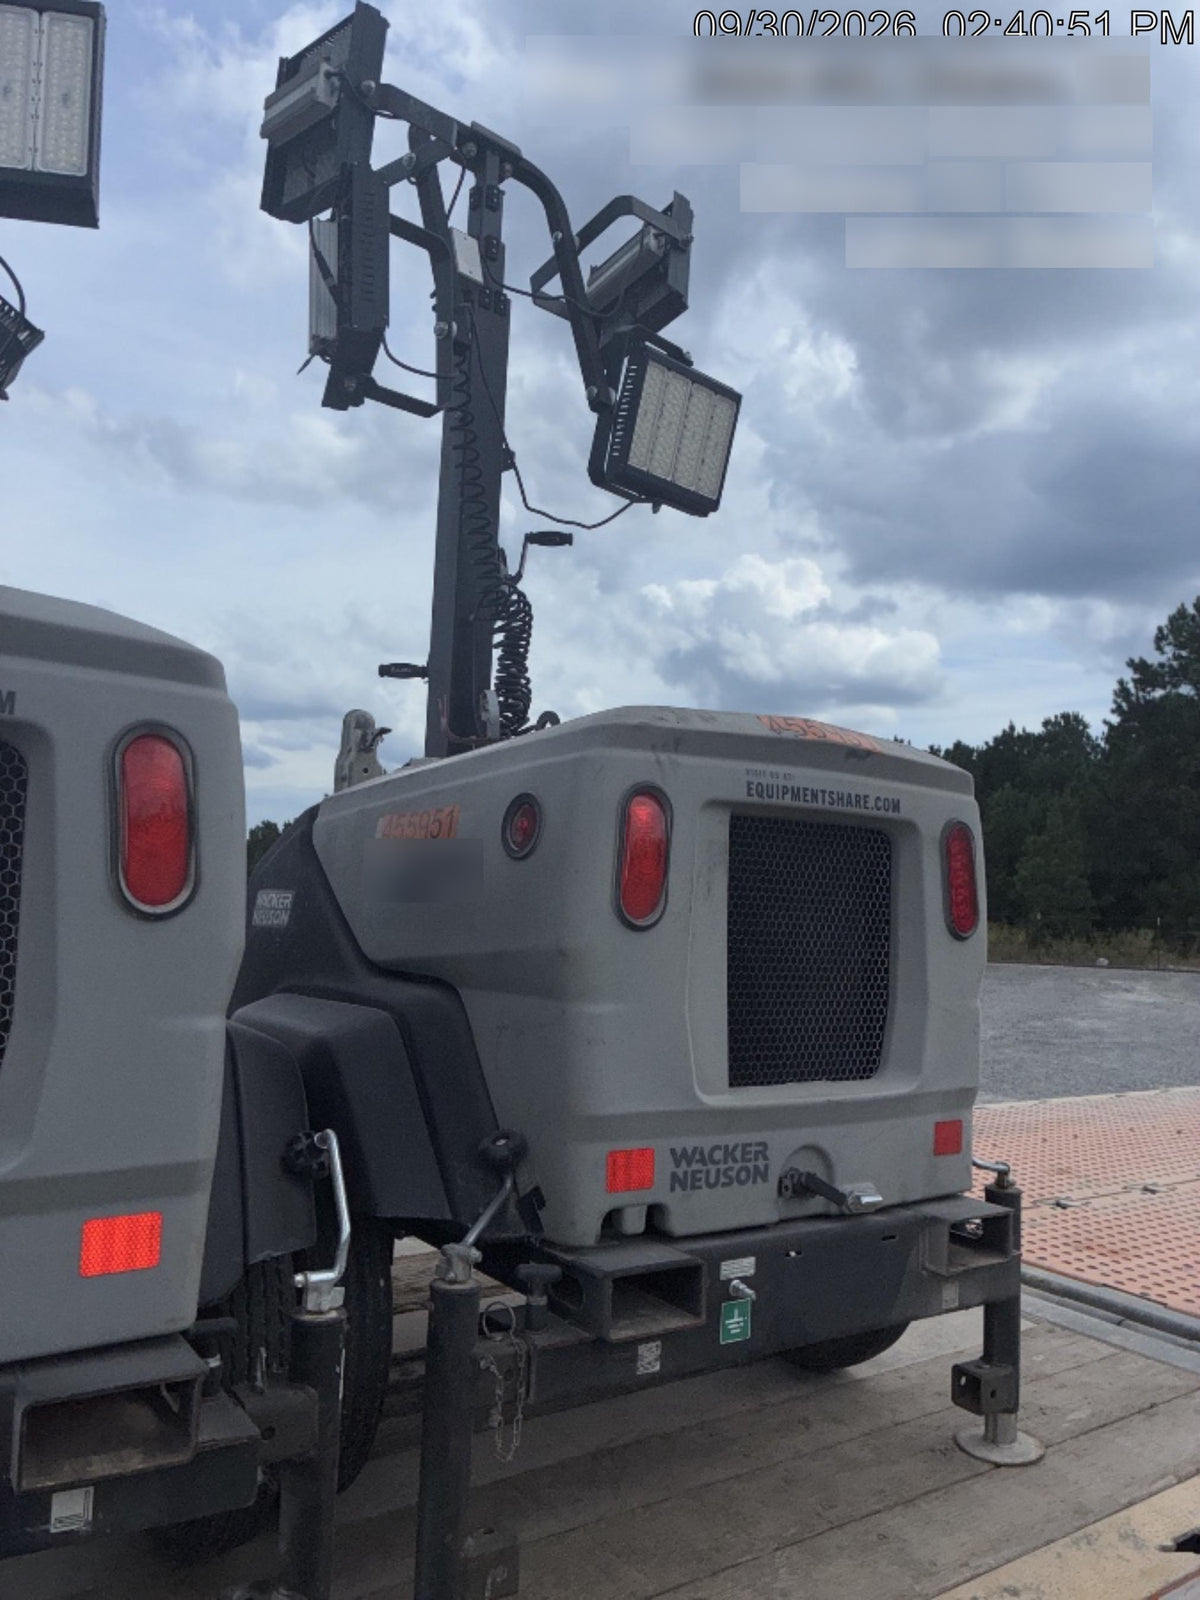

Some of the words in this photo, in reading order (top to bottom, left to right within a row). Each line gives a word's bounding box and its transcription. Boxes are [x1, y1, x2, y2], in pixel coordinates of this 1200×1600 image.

[745, 780, 901, 814] EQUIPMENTSHARE.COM
[669, 1141, 769, 1169] WACKER
[669, 1163, 769, 1193] NEUSON
